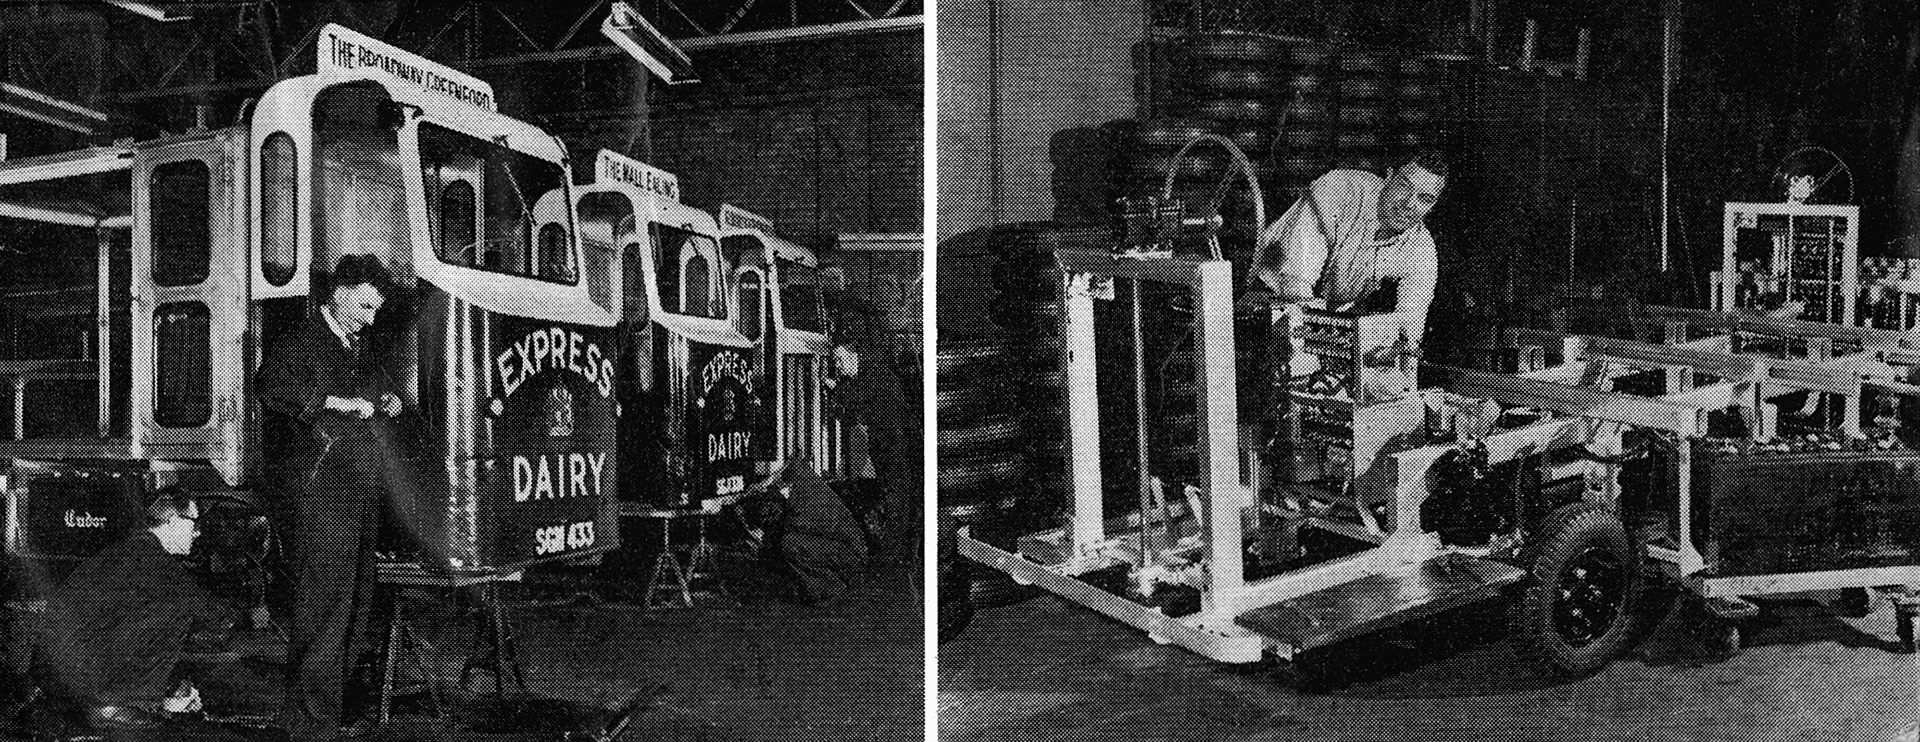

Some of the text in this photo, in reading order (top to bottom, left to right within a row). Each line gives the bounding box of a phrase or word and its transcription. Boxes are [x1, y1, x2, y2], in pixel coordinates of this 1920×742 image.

[328, 33, 356, 69] THE
[604, 155, 623, 182] THE
[497, 327, 614, 398] EXPRESS
[702, 350, 753, 394] EXPRESS
[708, 432, 751, 463] DAIRY
[513, 453, 606, 503] DAIRY
